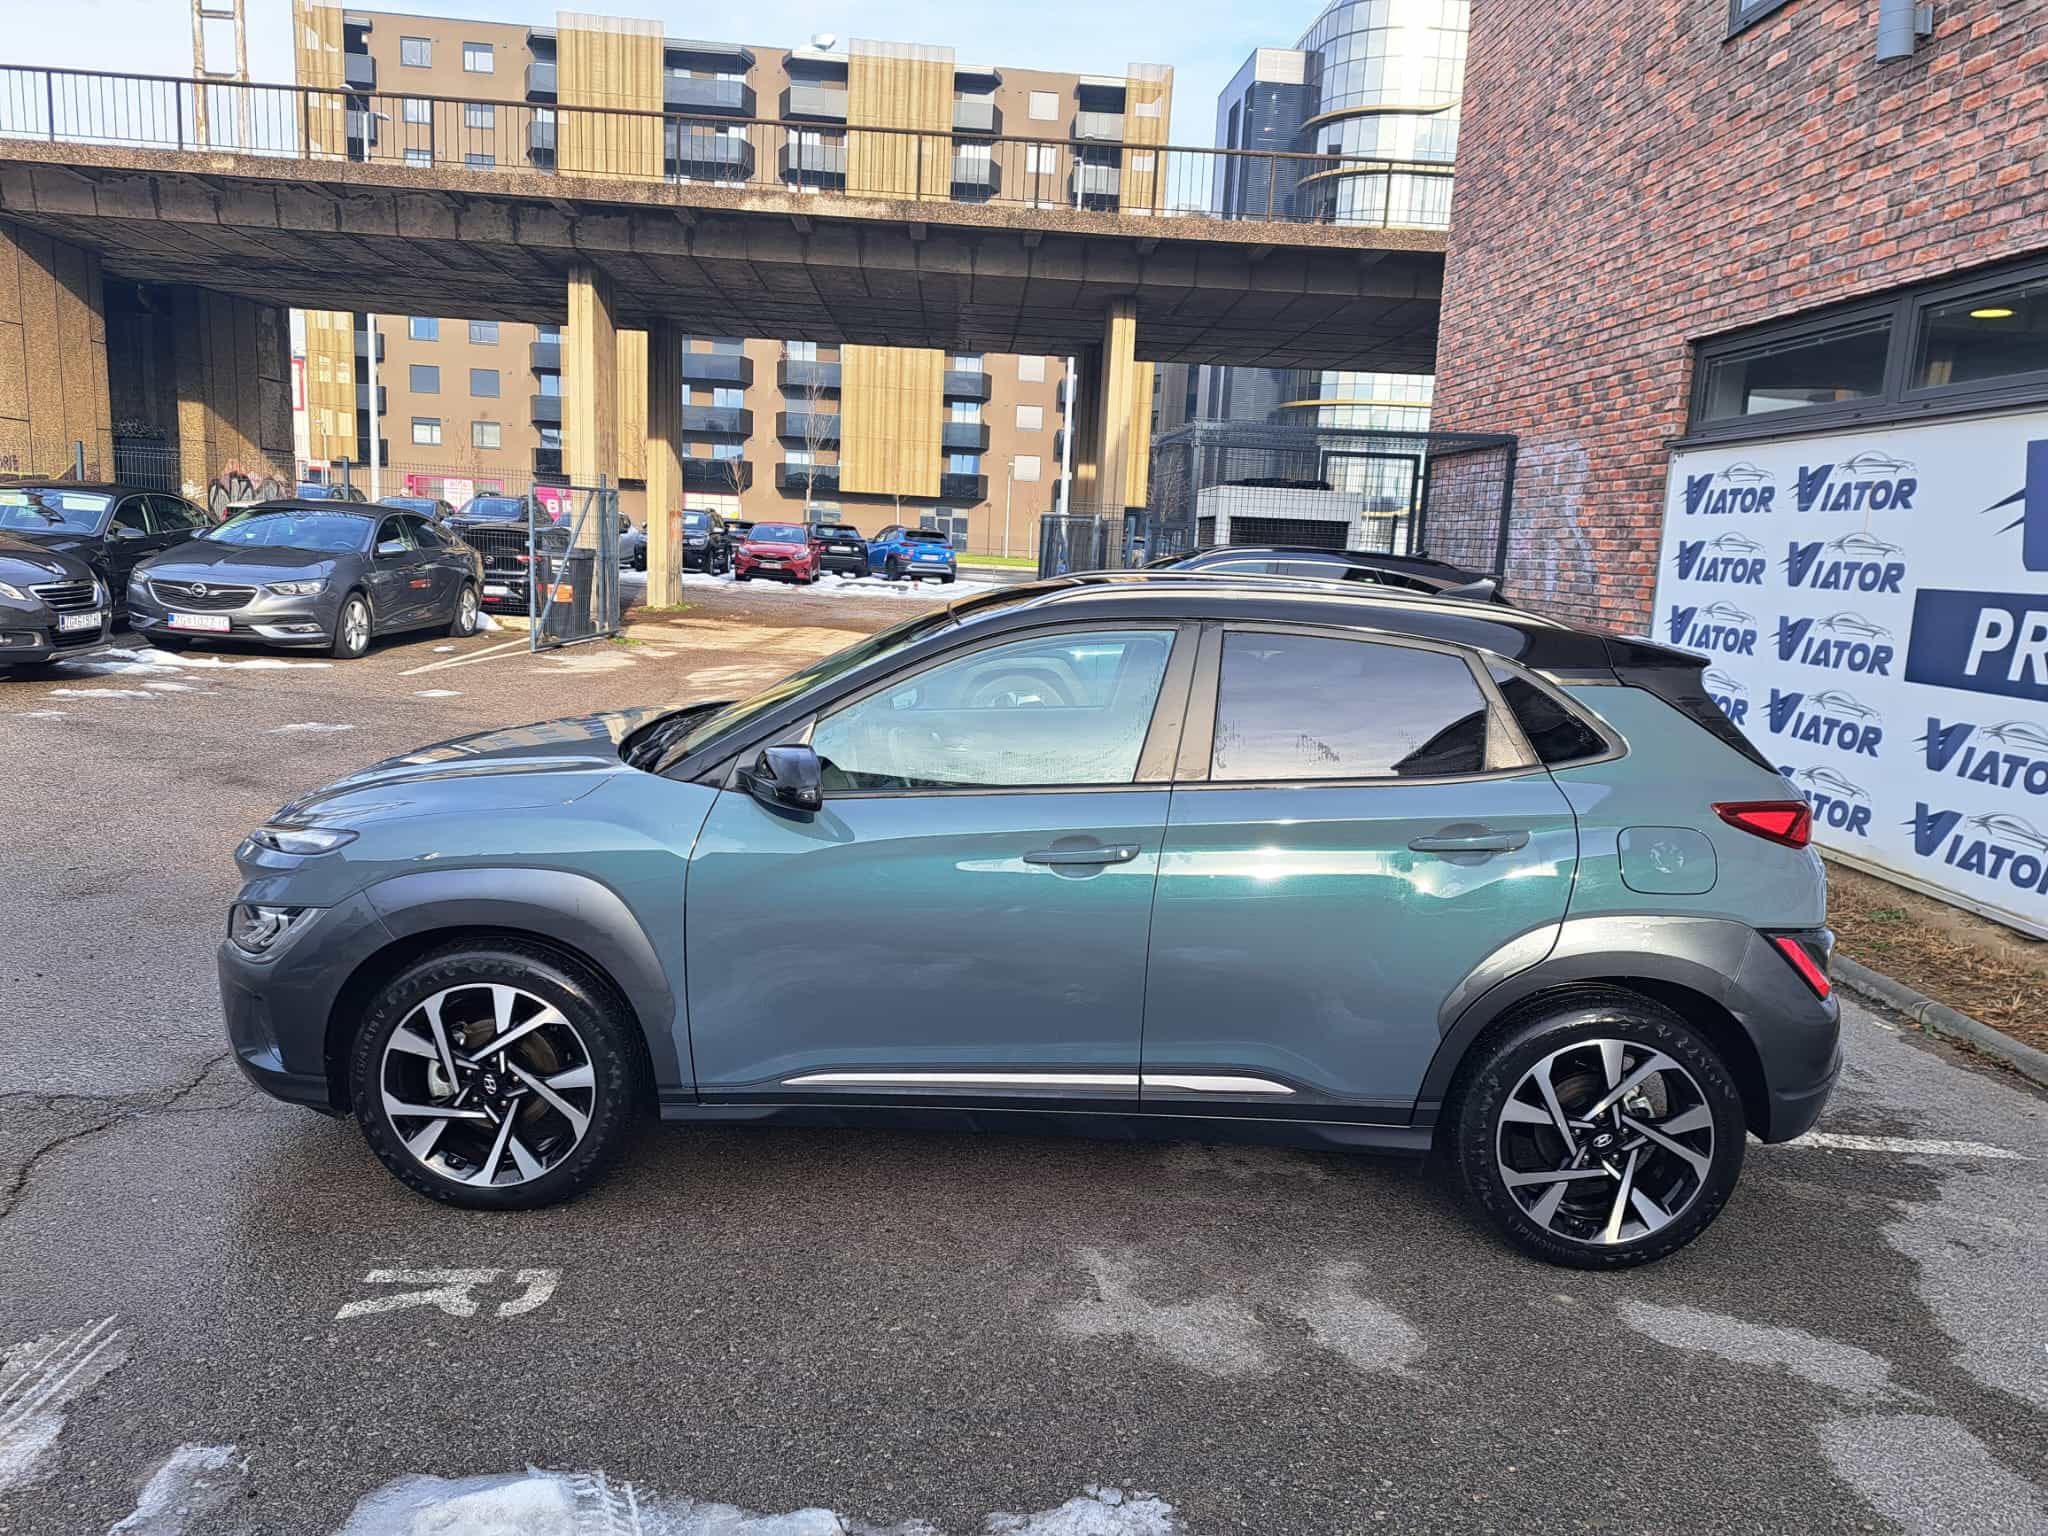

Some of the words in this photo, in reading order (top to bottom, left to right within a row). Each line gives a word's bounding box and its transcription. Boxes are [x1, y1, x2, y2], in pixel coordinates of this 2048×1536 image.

[1685, 472, 1775, 514] VIATOR
[1795, 463, 1918, 512] VIATOR
[1677, 540, 1767, 586] VIATOR
[1785, 541, 1906, 594] VIATOR
[1669, 605, 1758, 657] VIATOR
[1776, 615, 1894, 677] VIATOR
[1963, 607, 2048, 685] PR
[1766, 684, 1884, 758] VIATOR
